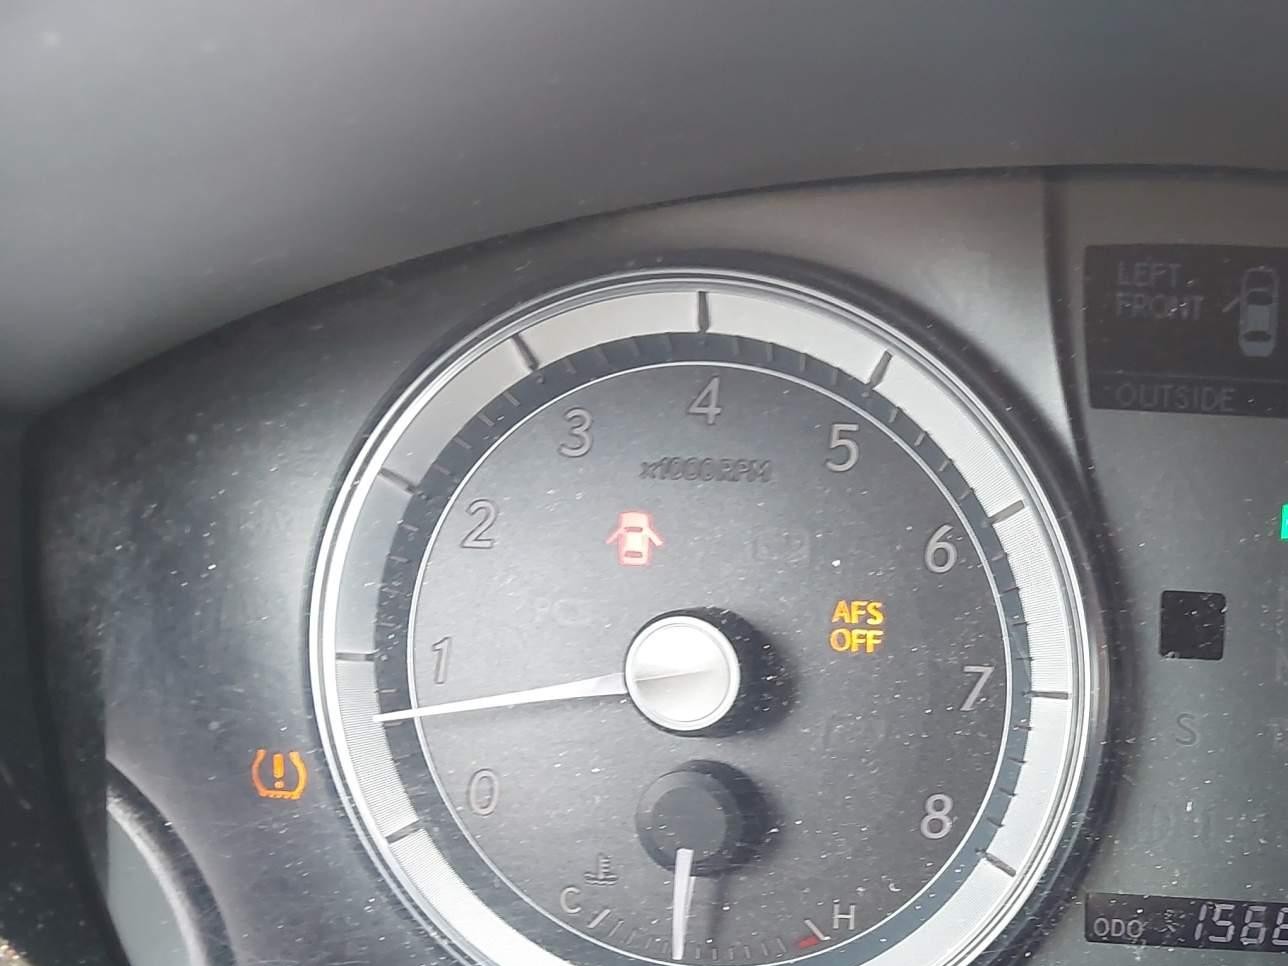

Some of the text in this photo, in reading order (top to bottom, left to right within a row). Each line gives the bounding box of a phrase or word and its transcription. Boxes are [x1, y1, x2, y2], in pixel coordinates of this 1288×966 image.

[1116, 261, 1183, 288] LEFT
[1115, 293, 1204, 320] FRONT
[687, 375, 722, 425] 4
[1115, 383, 1236, 413] OUTSIDE
[558, 407, 594, 459] 3
[826, 423, 861, 472] 5
[461, 500, 498, 549] 2
[924, 524, 959, 574] 6
[831, 600, 884, 627] AFS
[430, 635, 453, 684] 1
[829, 628, 883, 654] OFF
[960, 665, 995, 711] 7
[1176, 713, 1199, 746] S
[467, 767, 501, 817] 0
[920, 793, 954, 839] 8
[559, 885, 582, 915] C
[832, 903, 856, 930] H
[1093, 917, 1145, 939] ODO
